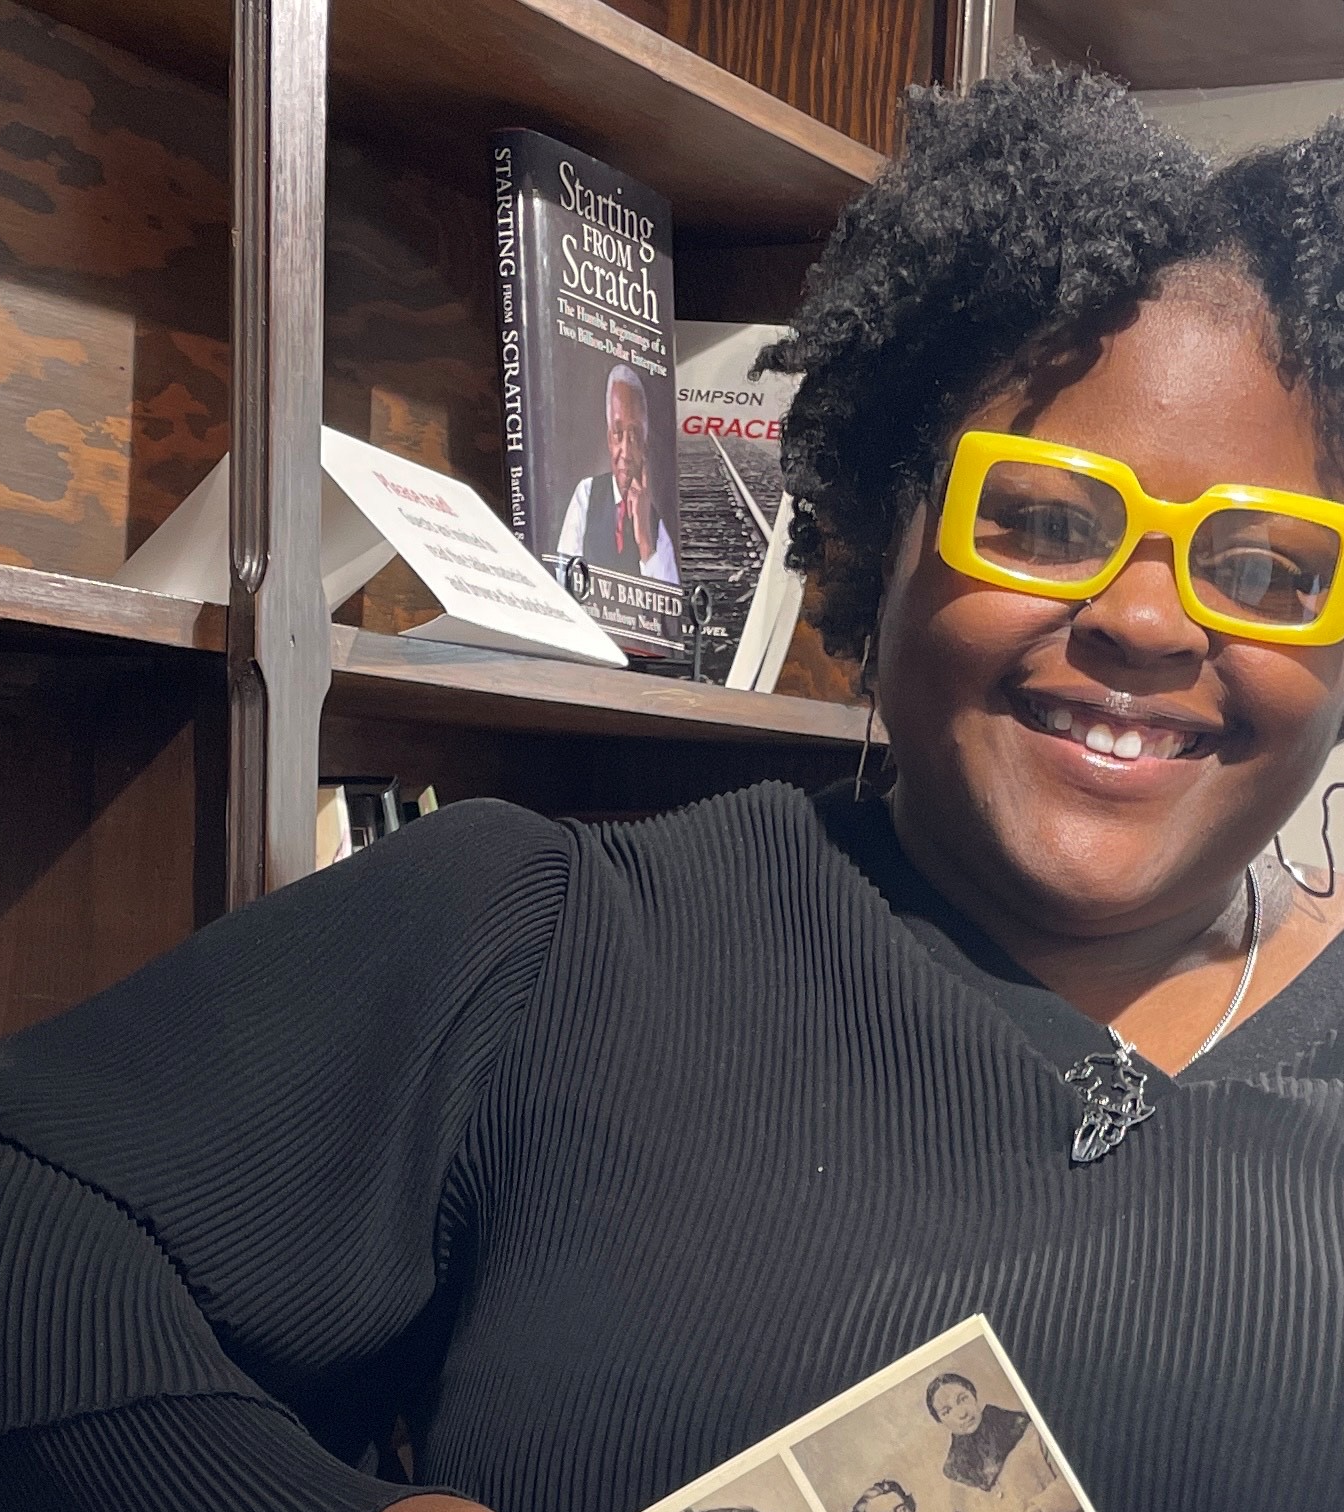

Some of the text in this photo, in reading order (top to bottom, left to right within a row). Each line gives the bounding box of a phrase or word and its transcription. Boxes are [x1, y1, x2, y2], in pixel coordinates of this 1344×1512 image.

[494, 147, 516, 277] STARTING
[559, 161, 655, 263] Starting
[582, 223, 633, 272] FROM
[502, 284, 513, 323] FROM
[562, 234, 659, 324] Scratch
[557, 298, 574, 317] The
[577, 305, 608, 330] Humble
[610, 319, 650, 351] Beginnings
[557, 320, 667, 377] Two Billion-Dollar Enterprise
[502, 329, 523, 452] SCRATCH
[677, 388, 764, 406] SIMPSON
[681, 415, 782, 440] GRACE
[510, 466, 526, 527] Barfield
[598, 579, 614, 601] W.
[618, 583, 683, 617] BARFIELD
[602, 606, 637, 630] Anthony
